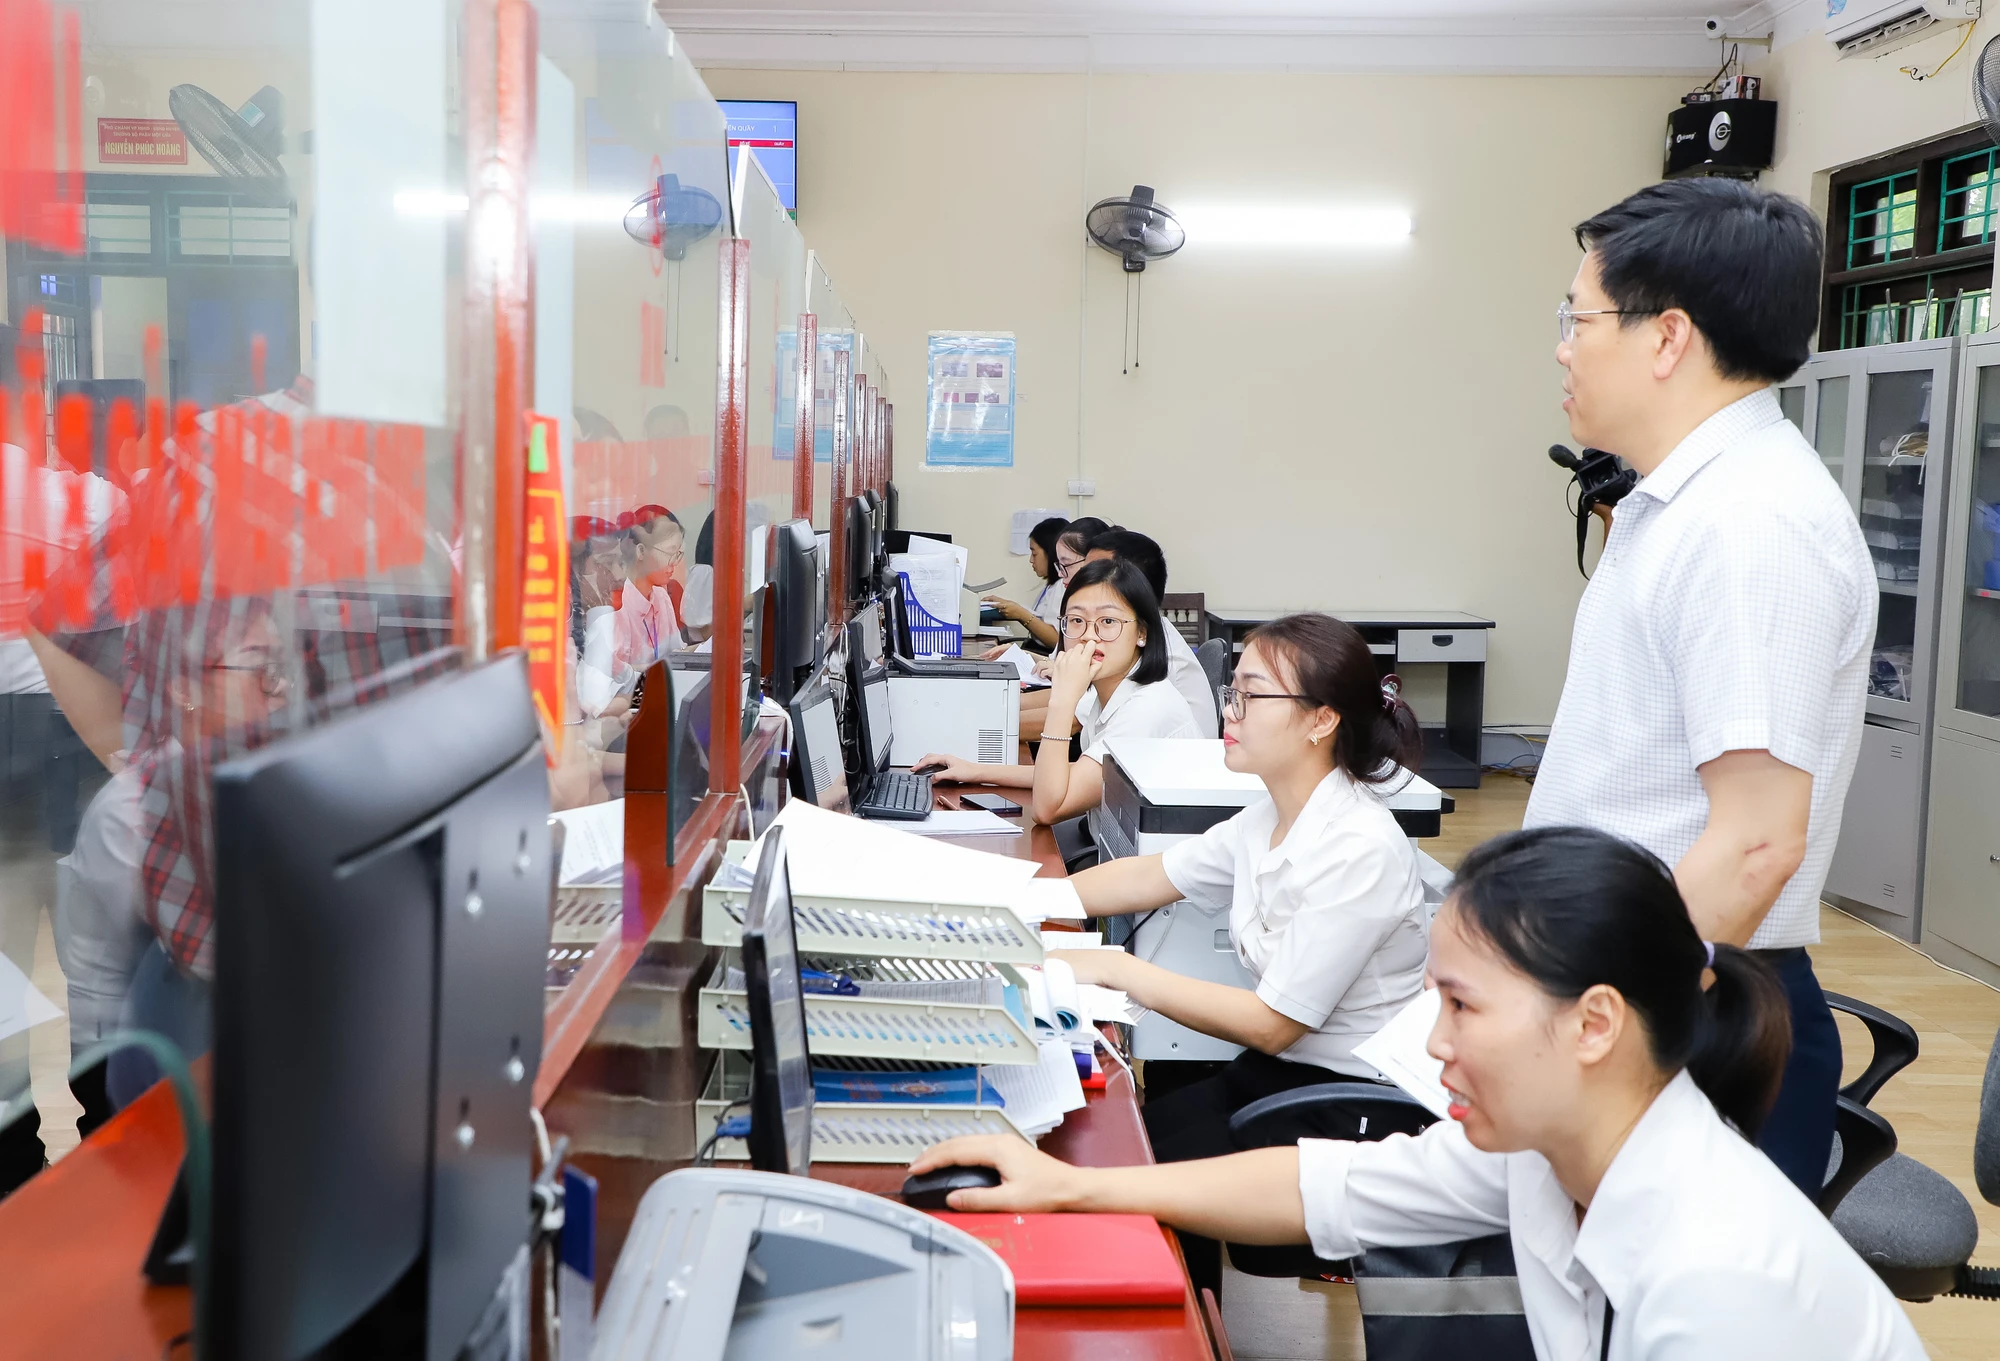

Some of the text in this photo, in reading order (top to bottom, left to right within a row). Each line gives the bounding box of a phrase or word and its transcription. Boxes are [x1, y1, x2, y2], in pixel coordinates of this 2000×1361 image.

[105, 138, 181, 156] NGUYỄN PHÚC HOÀNG
